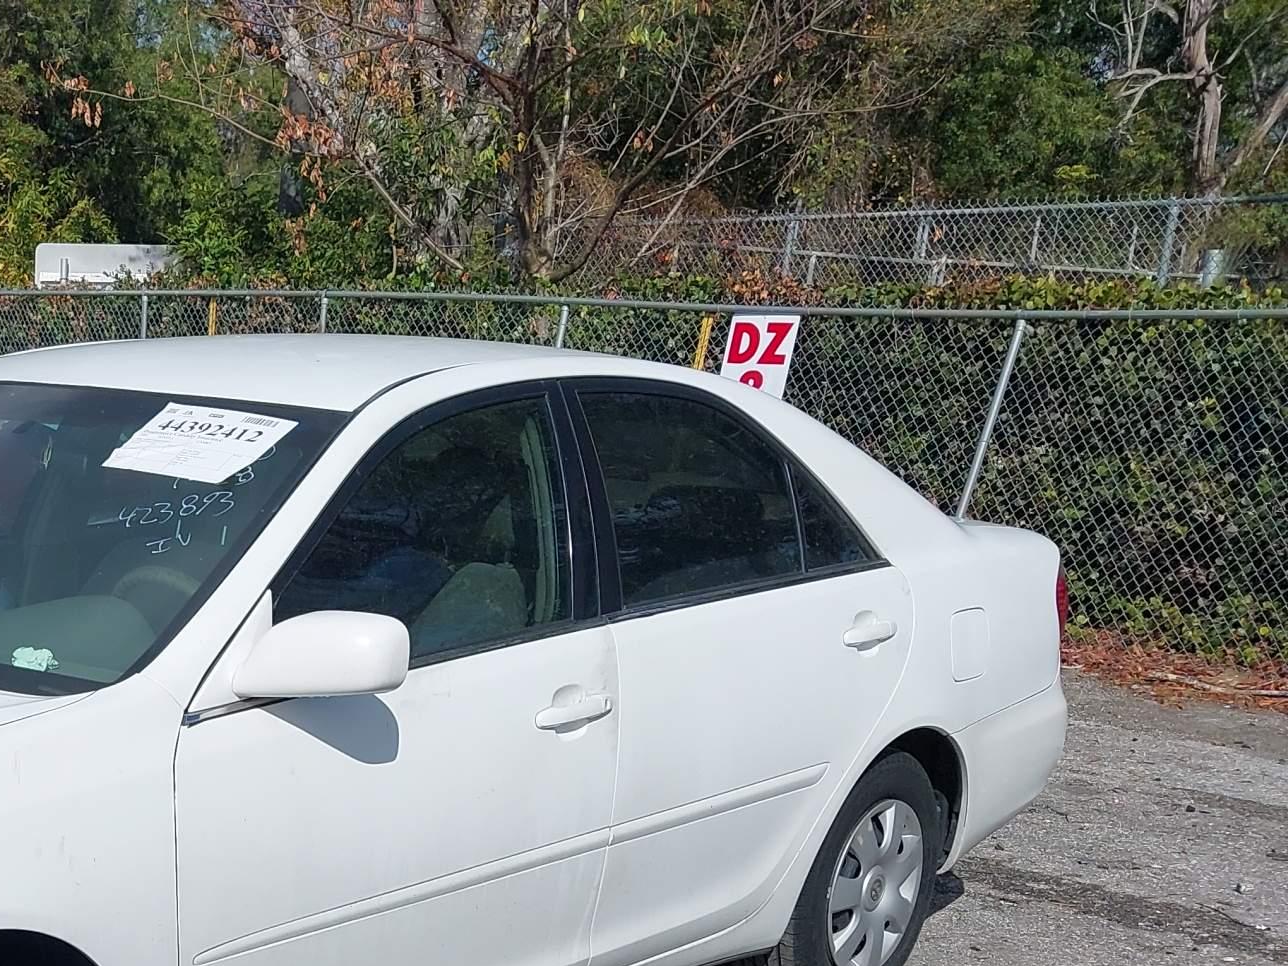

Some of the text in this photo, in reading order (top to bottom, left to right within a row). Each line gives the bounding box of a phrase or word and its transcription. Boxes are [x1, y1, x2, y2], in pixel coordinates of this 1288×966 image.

[727, 322, 794, 365] DZ
[158, 418, 264, 443] 44392412
[118, 491, 235, 528] 423893
